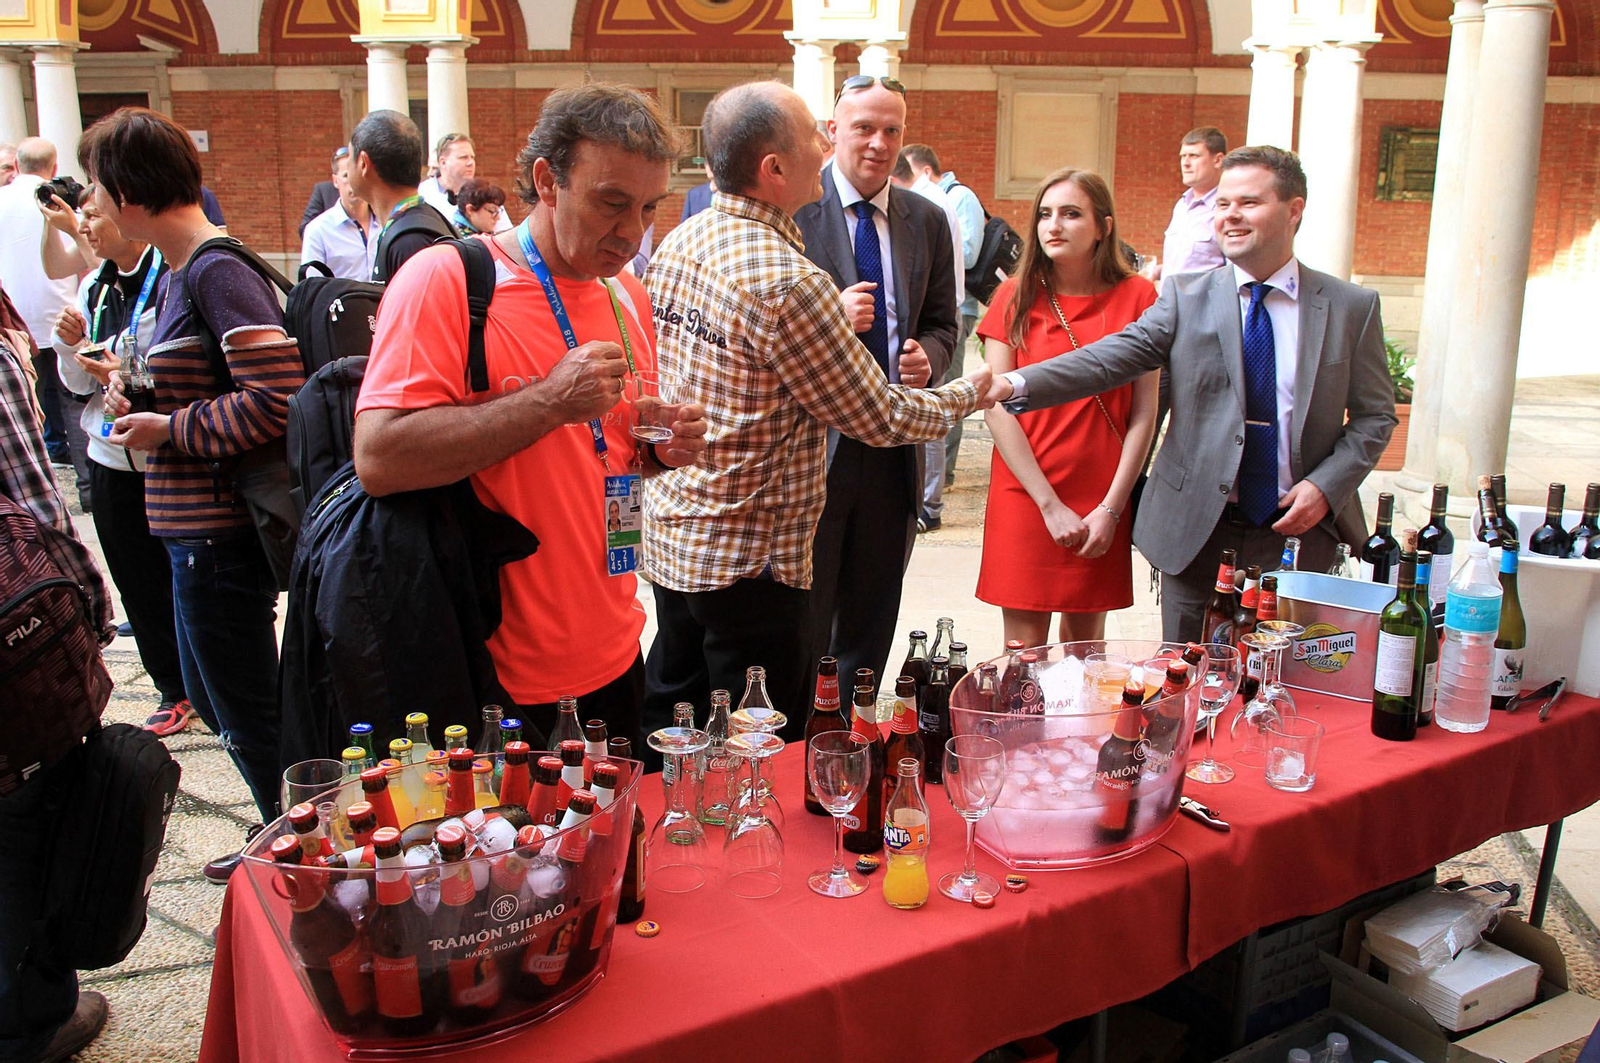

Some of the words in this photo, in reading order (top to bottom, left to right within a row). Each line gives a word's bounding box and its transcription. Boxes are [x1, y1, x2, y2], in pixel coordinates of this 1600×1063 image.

[652, 299, 684, 326] enter
[686, 309, 727, 349] Drive
[563, 329, 577, 350] 018
[5, 617, 42, 647] FILA
[1307, 653, 1340, 668] Clara
[428, 927, 504, 951] RAMÓN
[507, 903, 566, 935] BILBAO
[465, 947, 490, 959] HARO
[494, 940, 518, 952] RIOJA
[519, 932, 538, 944] ALTA
